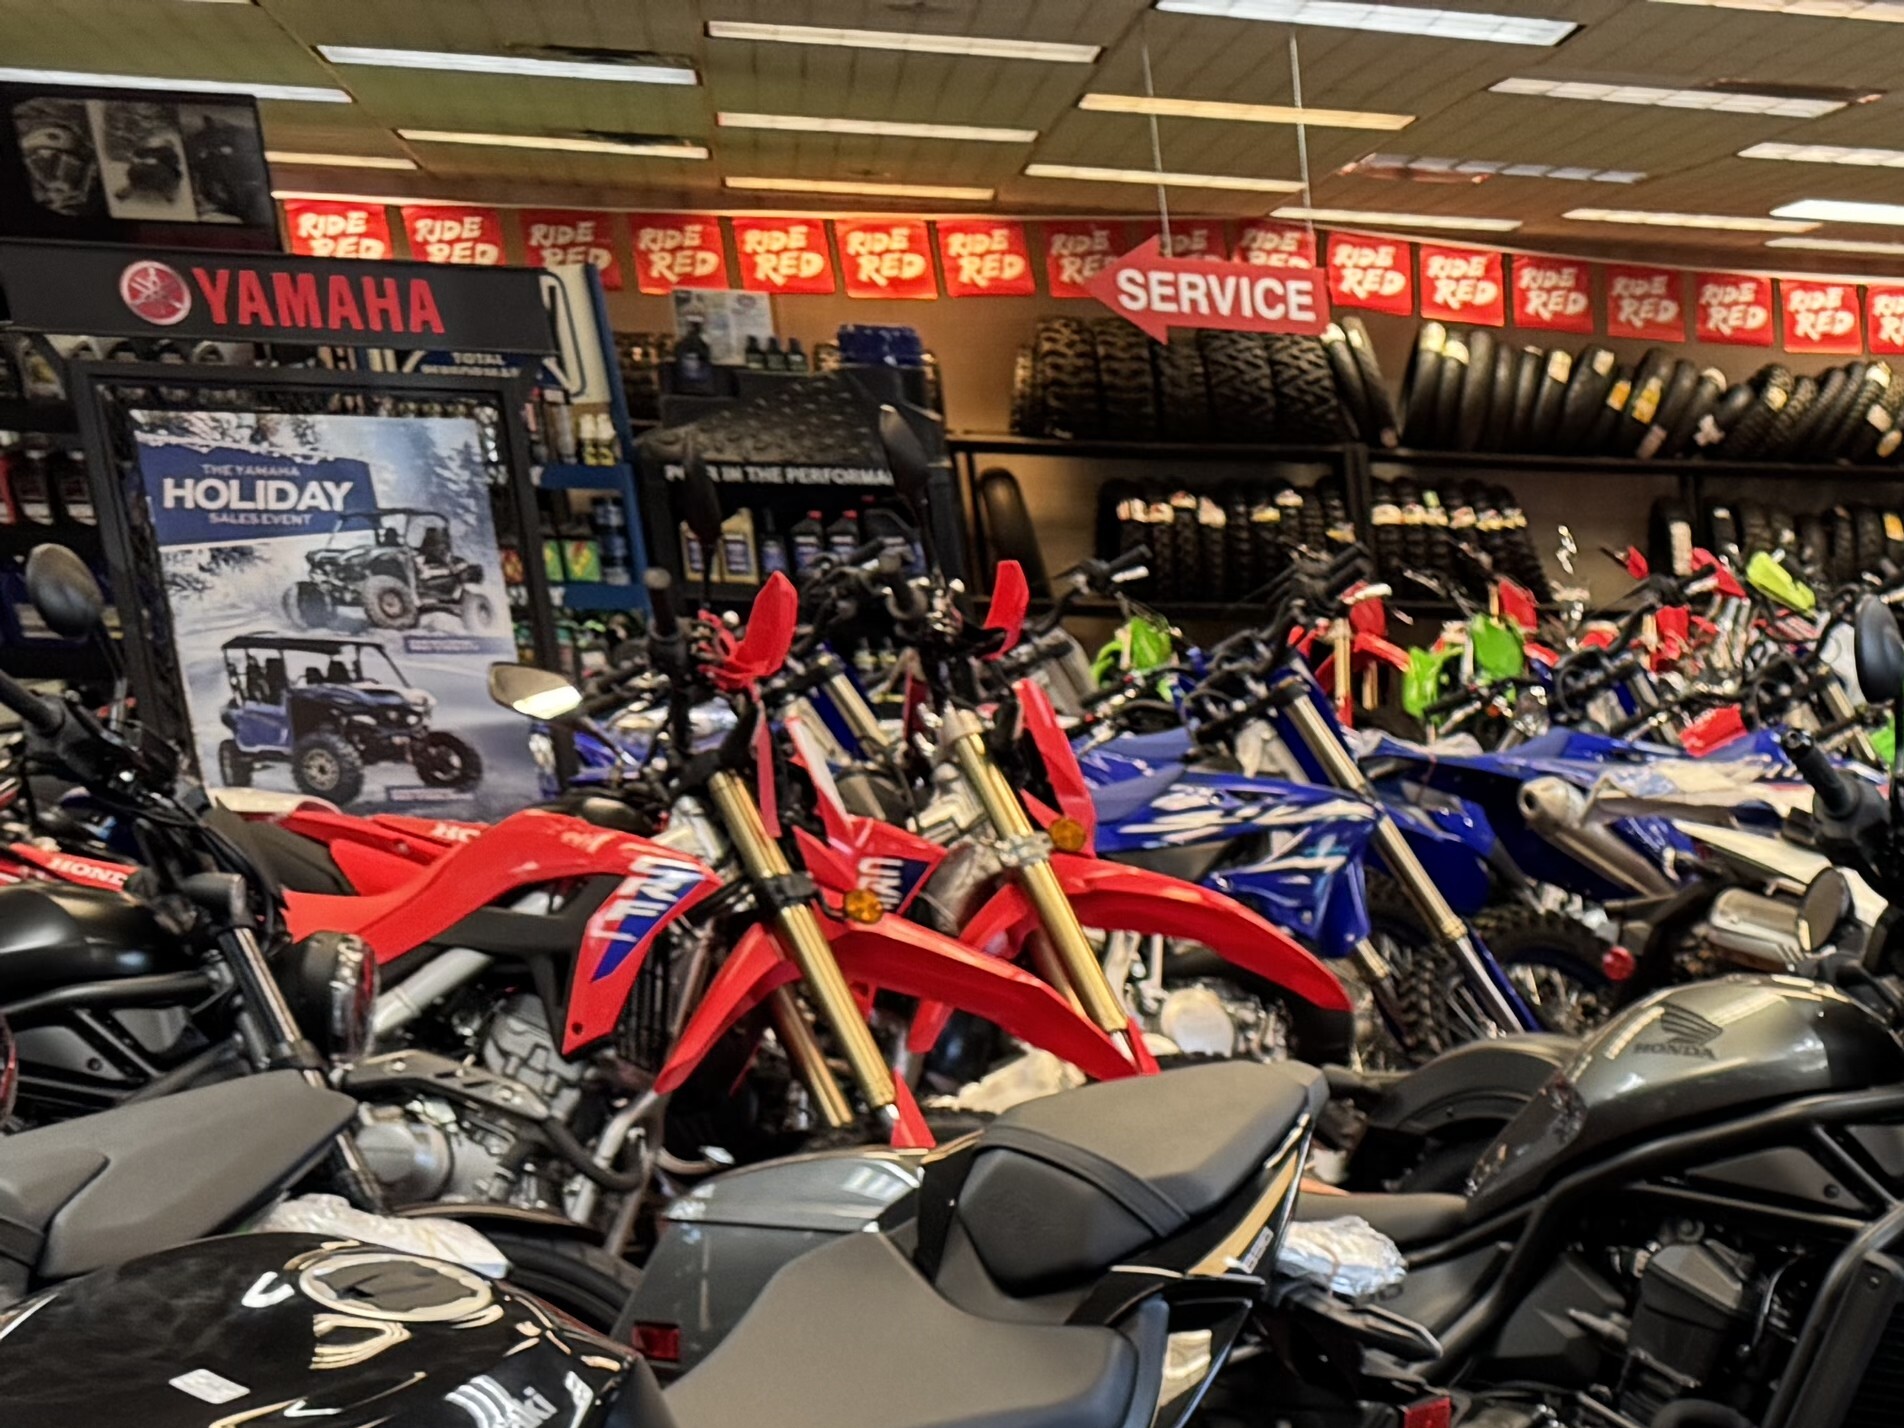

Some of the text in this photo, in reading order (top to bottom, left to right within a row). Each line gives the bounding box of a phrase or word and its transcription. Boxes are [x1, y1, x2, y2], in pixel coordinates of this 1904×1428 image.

[298, 211, 368, 238] RIDE
[414, 216, 483, 243] RIDE
[530, 221, 595, 247] RIDE
[638, 224, 703, 251] RIDE
[743, 225, 808, 253] RIDE
[847, 228, 910, 255] RIDE
[947, 229, 1010, 256] RIDE
[1051, 230, 1110, 255] RIDE
[1242, 228, 1299, 251] RIDE
[649, 251, 719, 283] RED
[754, 252, 825, 286] RED
[1333, 244, 1396, 268] RIDE
[1427, 255, 1487, 279] RIDE
[858, 253, 927, 287] RED
[958, 253, 1025, 287] RED
[1340, 268, 1406, 299] RED
[1519, 266, 1578, 290] RIDE
[192, 266, 445, 334] YAMAHA
[1116, 267, 1317, 323] SERVICE
[1433, 278, 1498, 310] RED
[1611, 275, 1669, 298] RIDE
[1700, 282, 1757, 305] RIDE
[1789, 287, 1844, 313] RIDE
[1525, 290, 1588, 320] RED
[1618, 298, 1679, 328] RED
[1706, 304, 1768, 336] RED
[1794, 311, 1855, 342] RED
[201, 463, 300, 478] THE YAMAHA
[746, 466, 784, 483] THE
[785, 467, 894, 485] PERFORMA
[162, 476, 354, 512] HOLIDAY
[208, 512, 313, 526] SALES EVENT
[48, 858, 129, 886] HOND
[1633, 1043, 1718, 1060] HONDA
